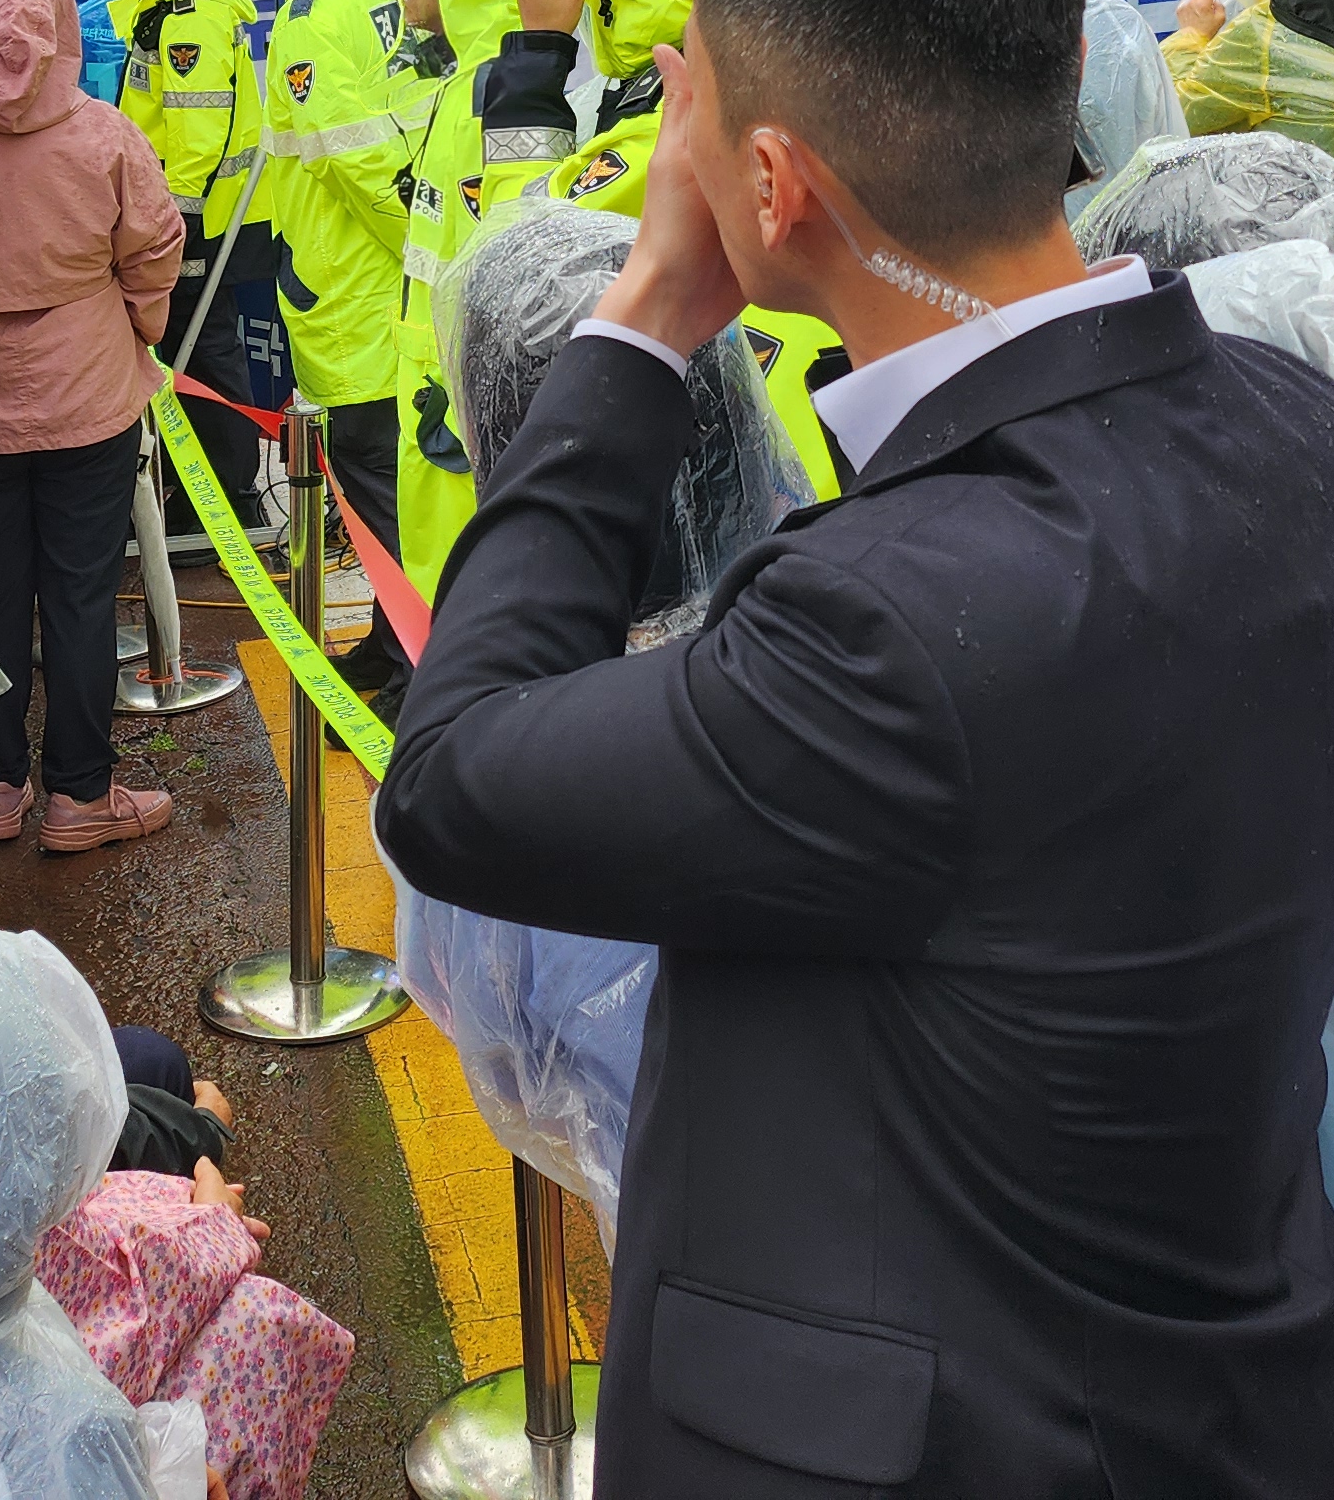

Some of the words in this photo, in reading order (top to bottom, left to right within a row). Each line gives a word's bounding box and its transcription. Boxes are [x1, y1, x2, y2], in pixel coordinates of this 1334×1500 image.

[192, 477, 220, 507] POLICE
[306, 673, 335, 696] LINE
[320, 690, 360, 722] POLICE
